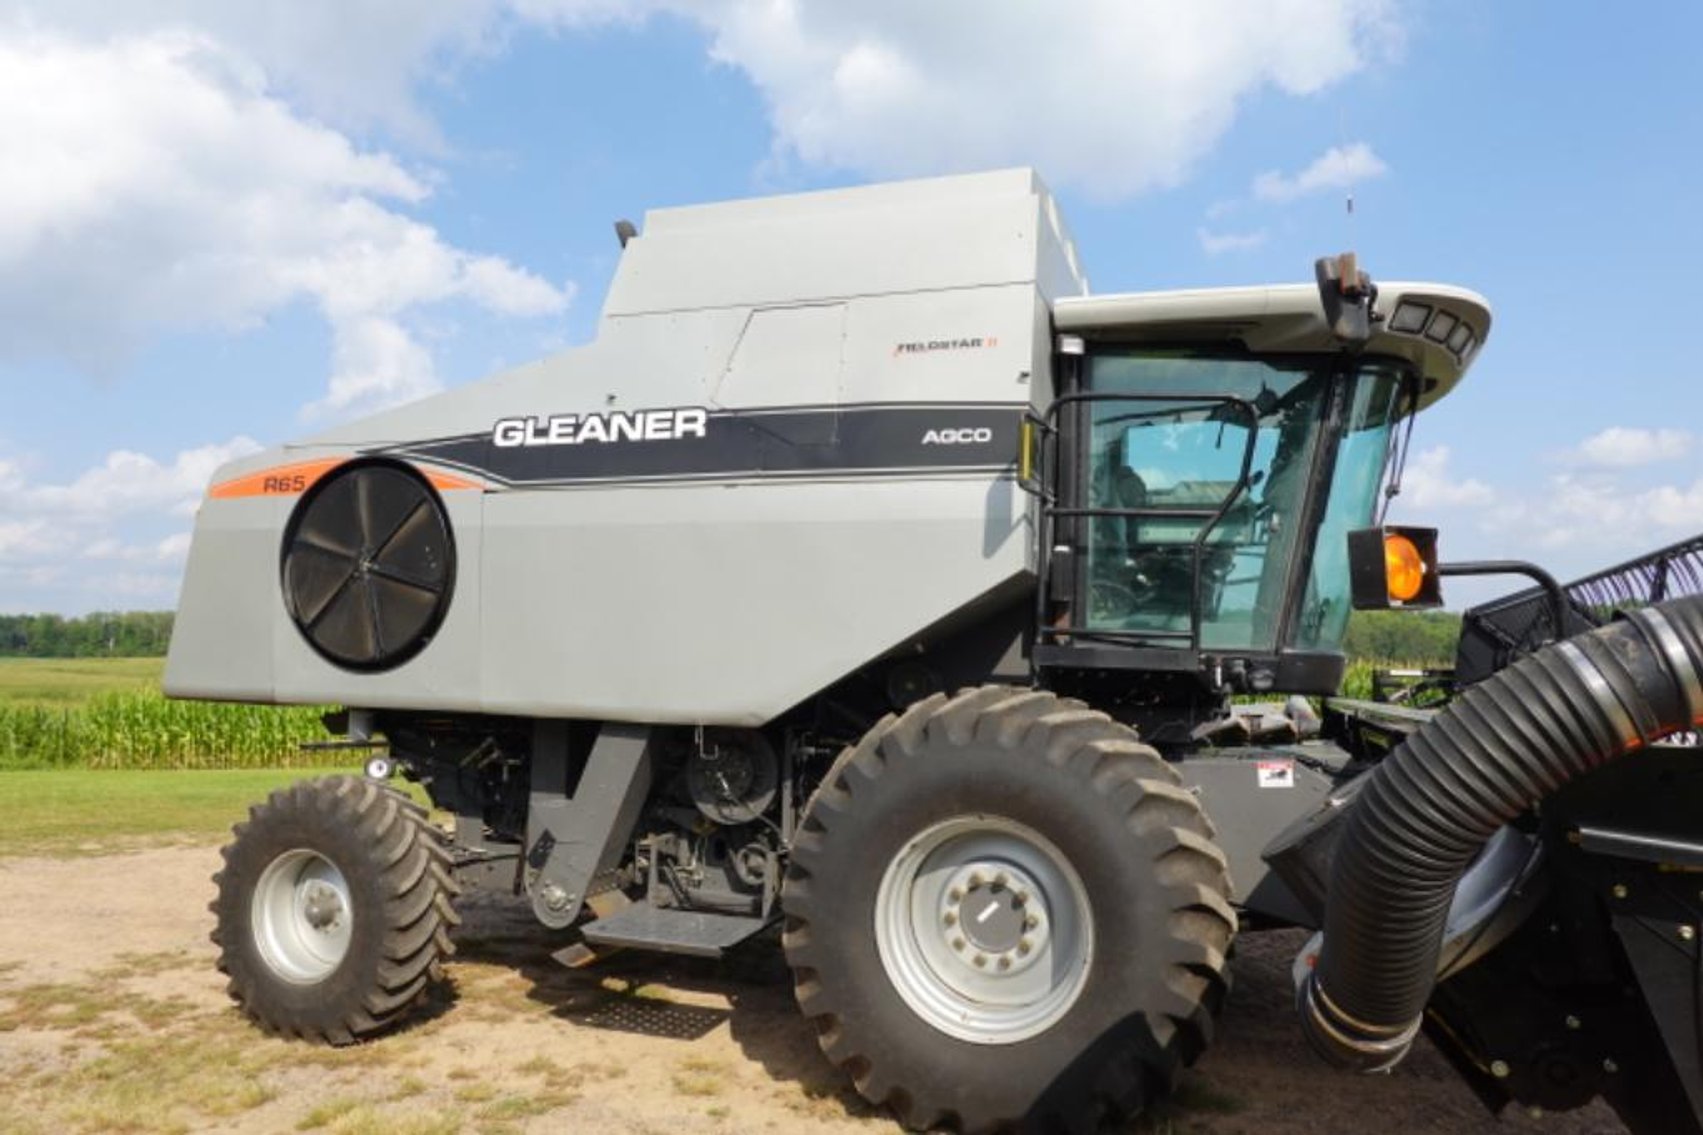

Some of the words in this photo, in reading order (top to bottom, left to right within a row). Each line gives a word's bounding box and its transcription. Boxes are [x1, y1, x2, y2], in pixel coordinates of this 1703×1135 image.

[493, 408, 706, 447] GLEANER
[921, 427, 992, 444] AGCO
[263, 475, 306, 493] R65
